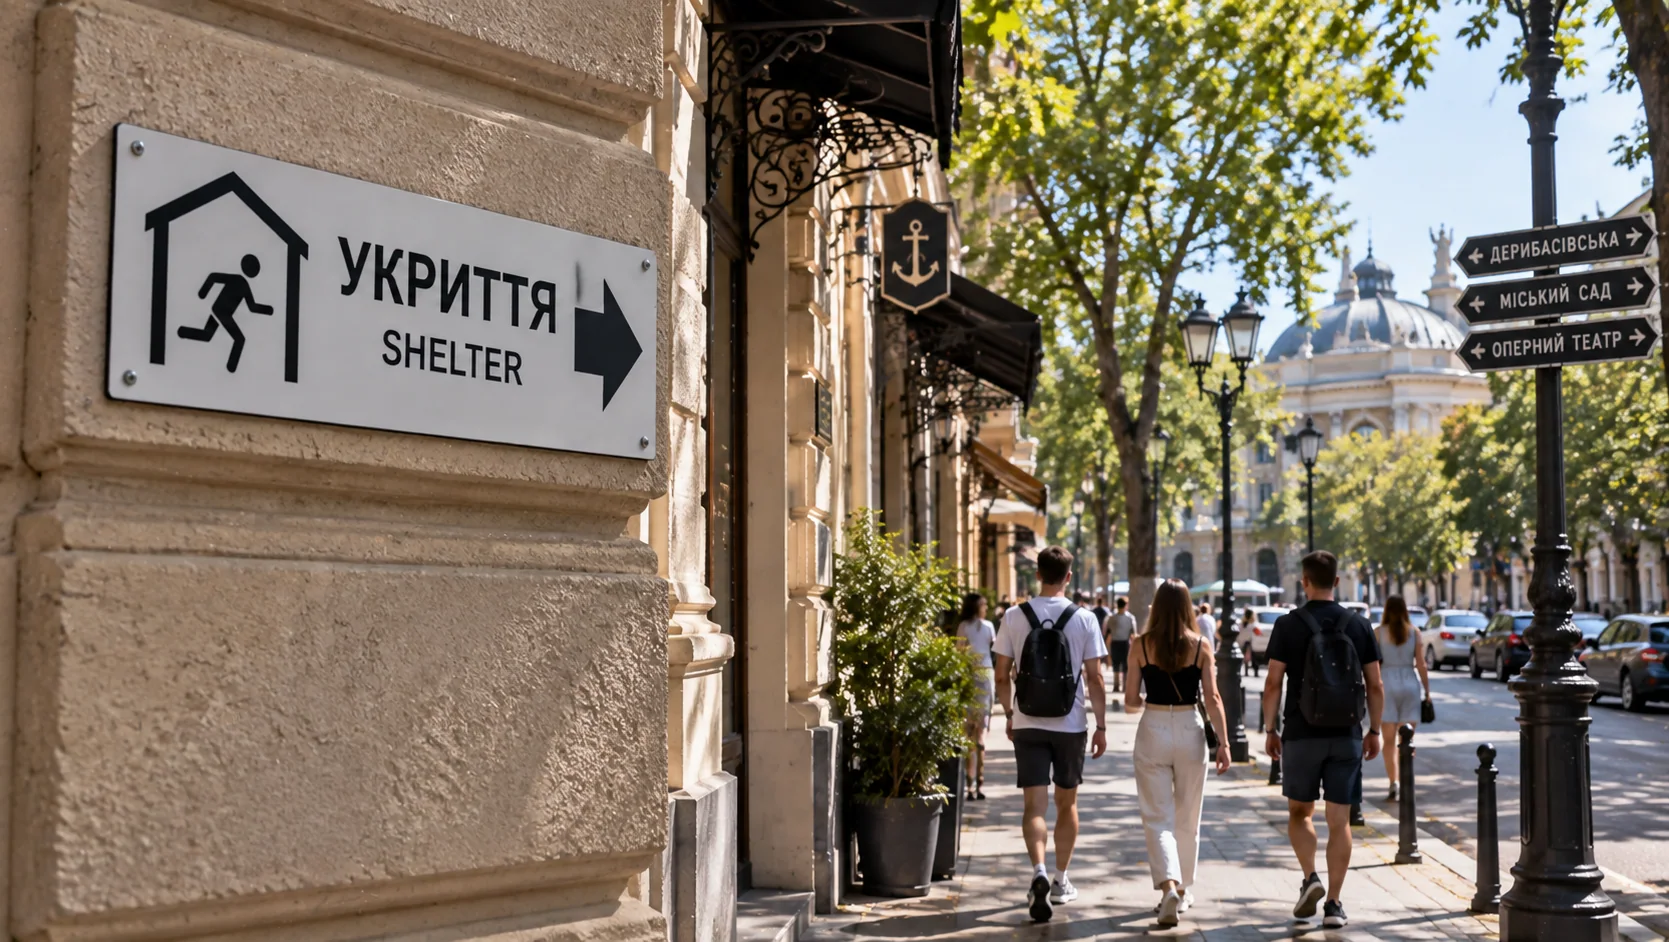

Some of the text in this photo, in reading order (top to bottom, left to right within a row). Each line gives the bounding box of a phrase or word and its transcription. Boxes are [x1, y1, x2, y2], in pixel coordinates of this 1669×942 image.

[1490, 231, 1619, 264] ДЕРИБАСІВСЬКА
[337, 236, 556, 334] УКРИТТЯ
[1500, 282, 1612, 309] МІСЬКИЙ САД
[382, 329, 523, 386] SHELTER
[1492, 331, 1622, 358] ОПЕРНИЙ ТЕАТР
